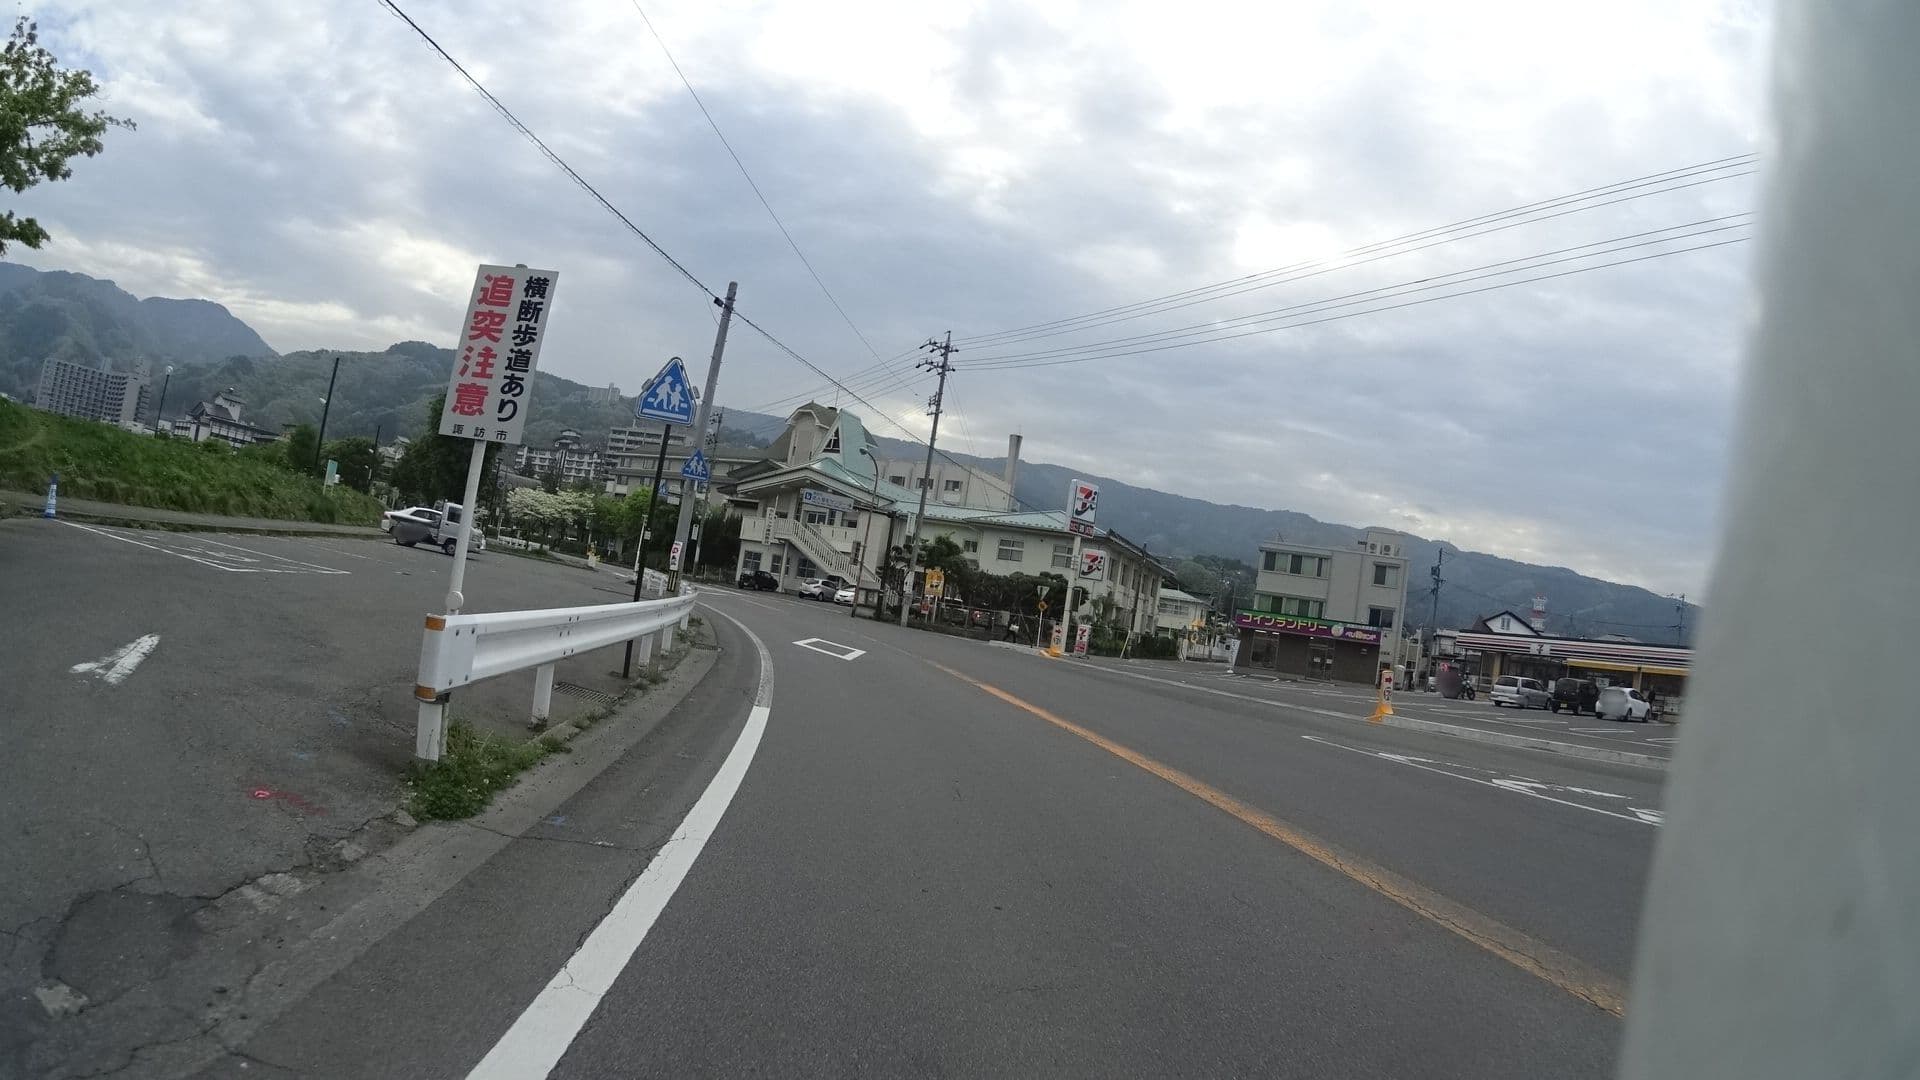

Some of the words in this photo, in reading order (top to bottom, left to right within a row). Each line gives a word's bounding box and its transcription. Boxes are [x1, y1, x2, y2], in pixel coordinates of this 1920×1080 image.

[451, 274, 515, 416] 追突注意
[497, 276, 550, 422] 横断歩道あり
[452, 424, 508, 440] 諏訪市
[1242, 612, 1328, 631] コインランドリー
